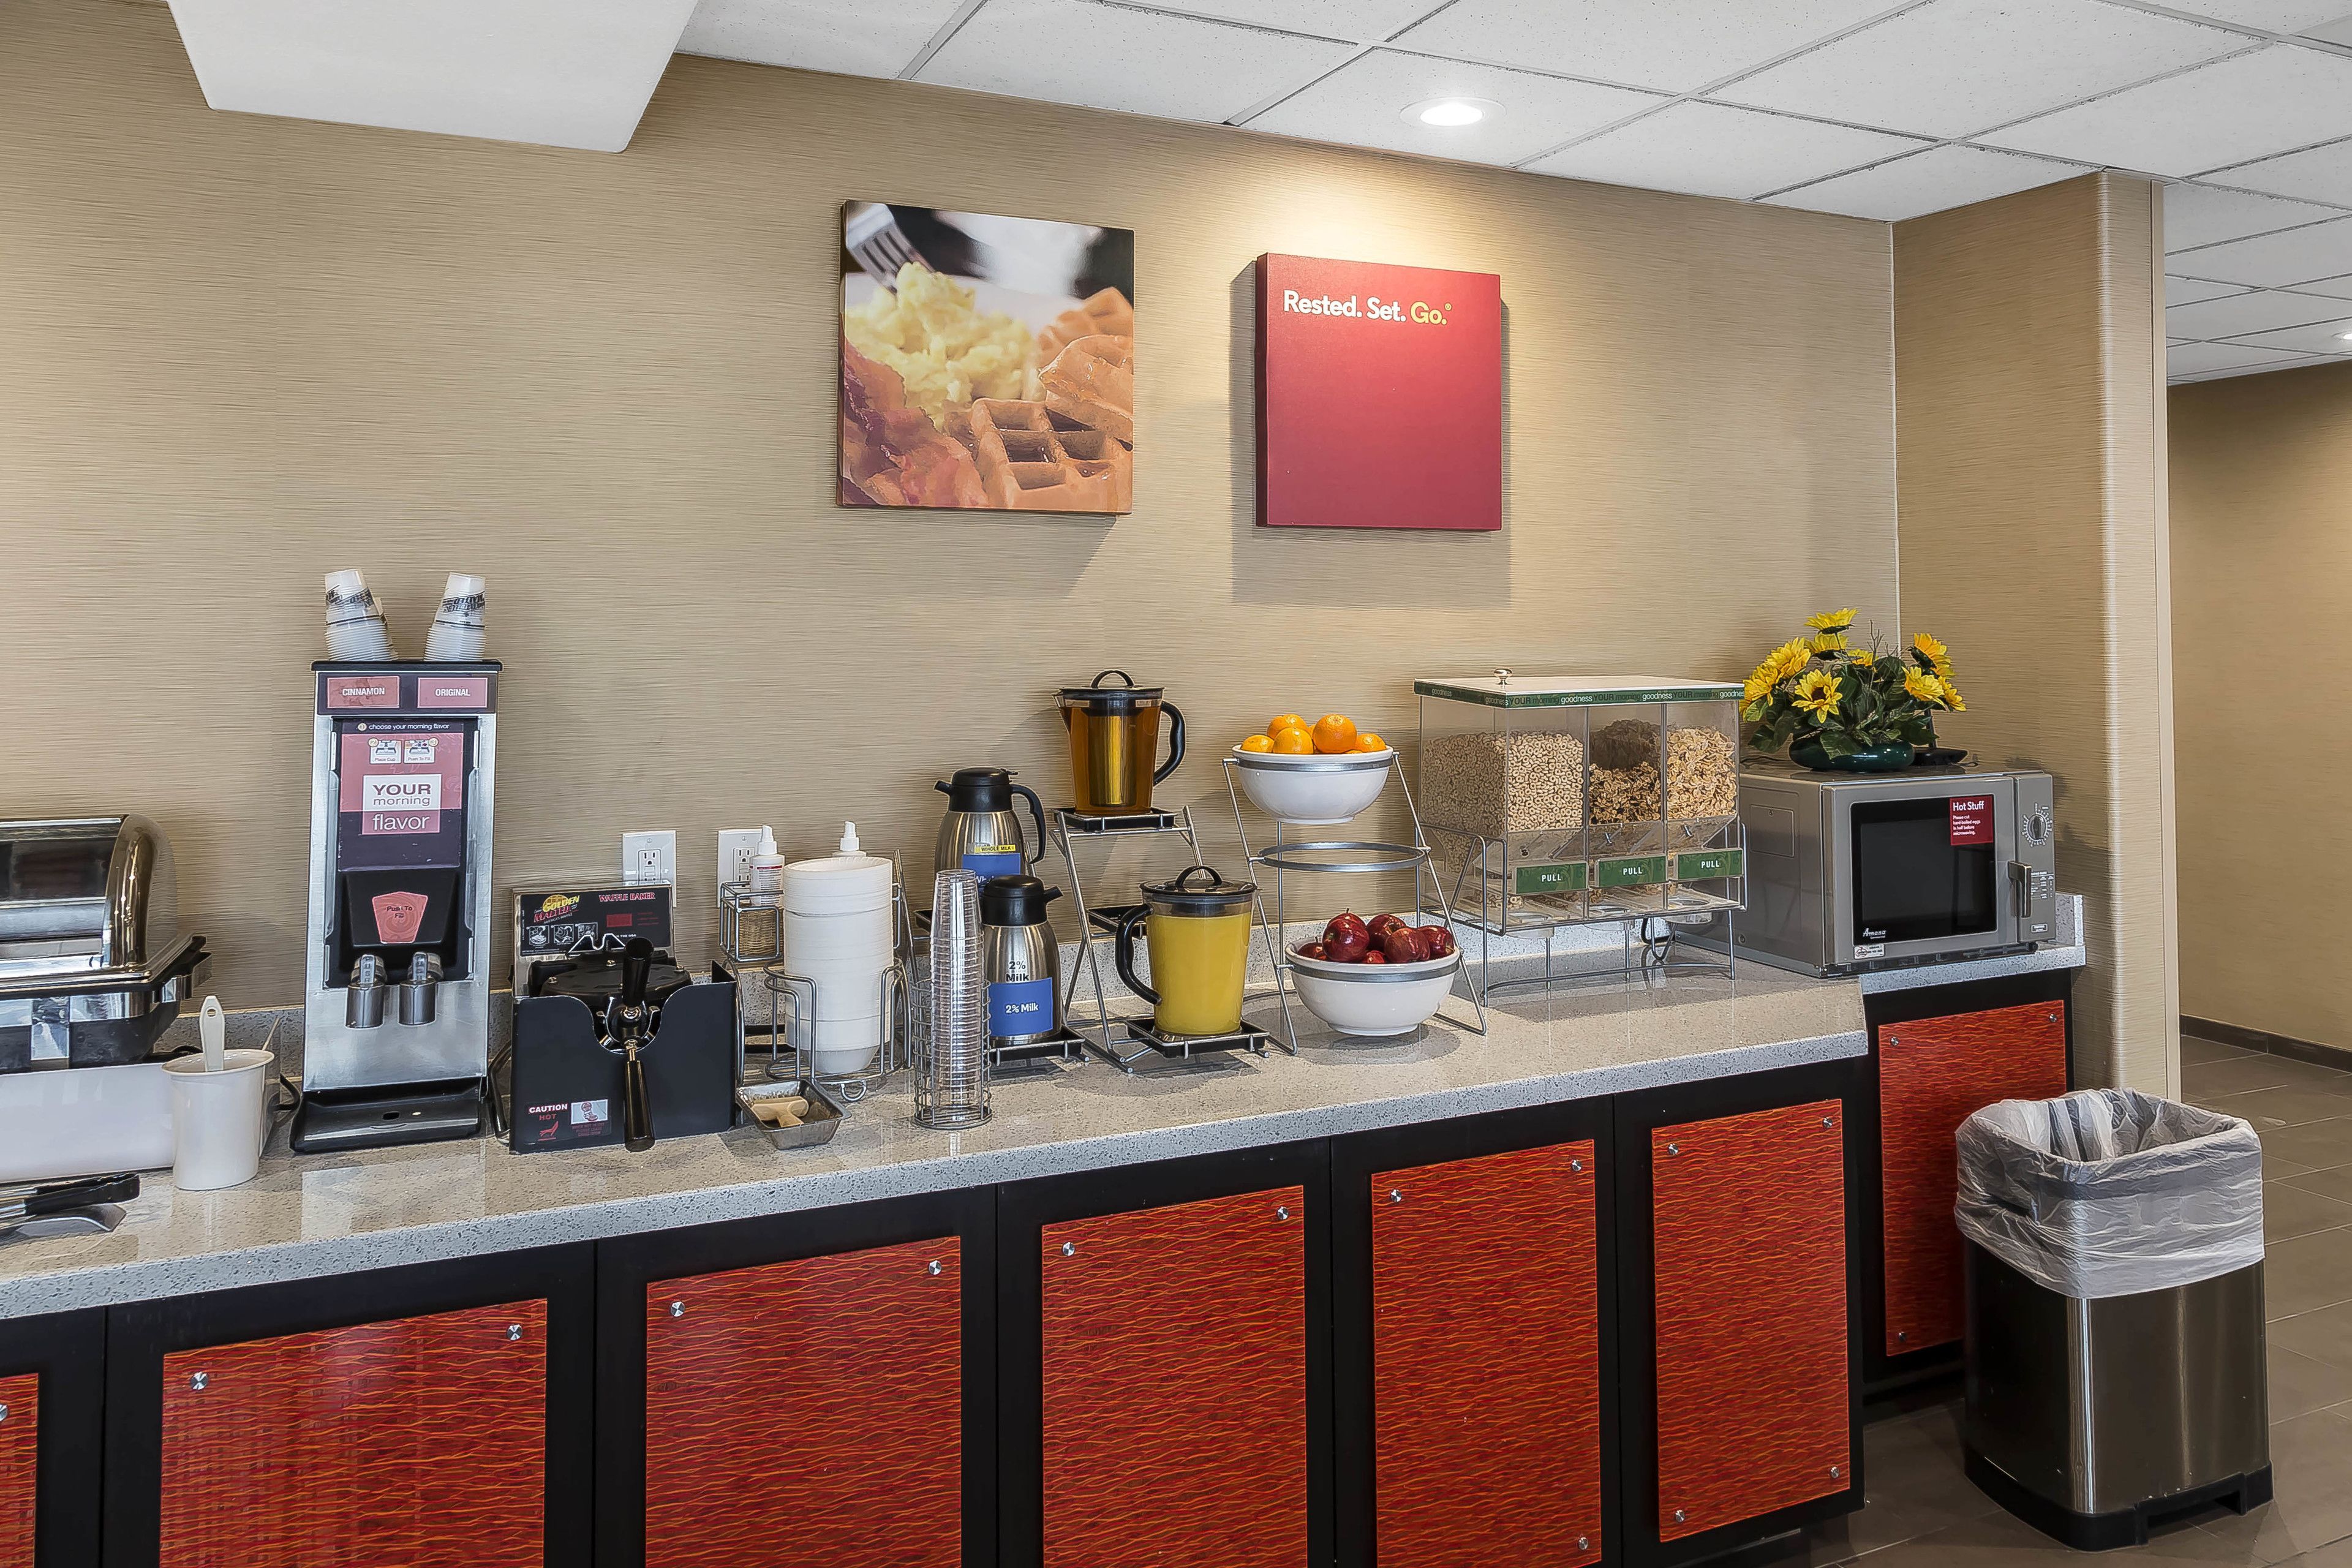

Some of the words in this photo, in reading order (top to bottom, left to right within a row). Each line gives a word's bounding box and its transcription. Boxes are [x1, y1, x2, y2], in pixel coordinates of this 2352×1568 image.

[1283, 290, 1363, 318] Rested.
[1366, 296, 1407, 322] Set.
[342, 687, 385, 696] CINNAMON
[1431, 688, 1452, 697] goodness
[1485, 697, 1509, 706] goodness
[1561, 695, 1593, 705] goodness
[1642, 692, 1673, 701] goodness
[1720, 689, 1744, 699] goodnes
[372, 783, 431, 796] YOUR
[373, 796, 431, 807] morning
[1953, 802, 1966, 811] Hot
[1967, 801, 1985, 810] Stuff
[372, 813, 430, 831] flavor
[1701, 860, 1720, 869] PULL
[1623, 867, 1642, 875] PULL
[1542, 873, 1562, 882] PULL
[630, 892, 656, 900] BAKER
[543, 895, 579, 912] GOLDEN
[533, 906, 571, 923] MALTED
[1863, 928, 1887, 937] Amana
[1009, 960, 1026, 970] 2%
[1006, 973, 1029, 982] Milk
[1006, 1005, 1020, 1014] 2%
[1020, 1003, 1039, 1012] Milk
[529, 1104, 568, 1114] CAUTION
